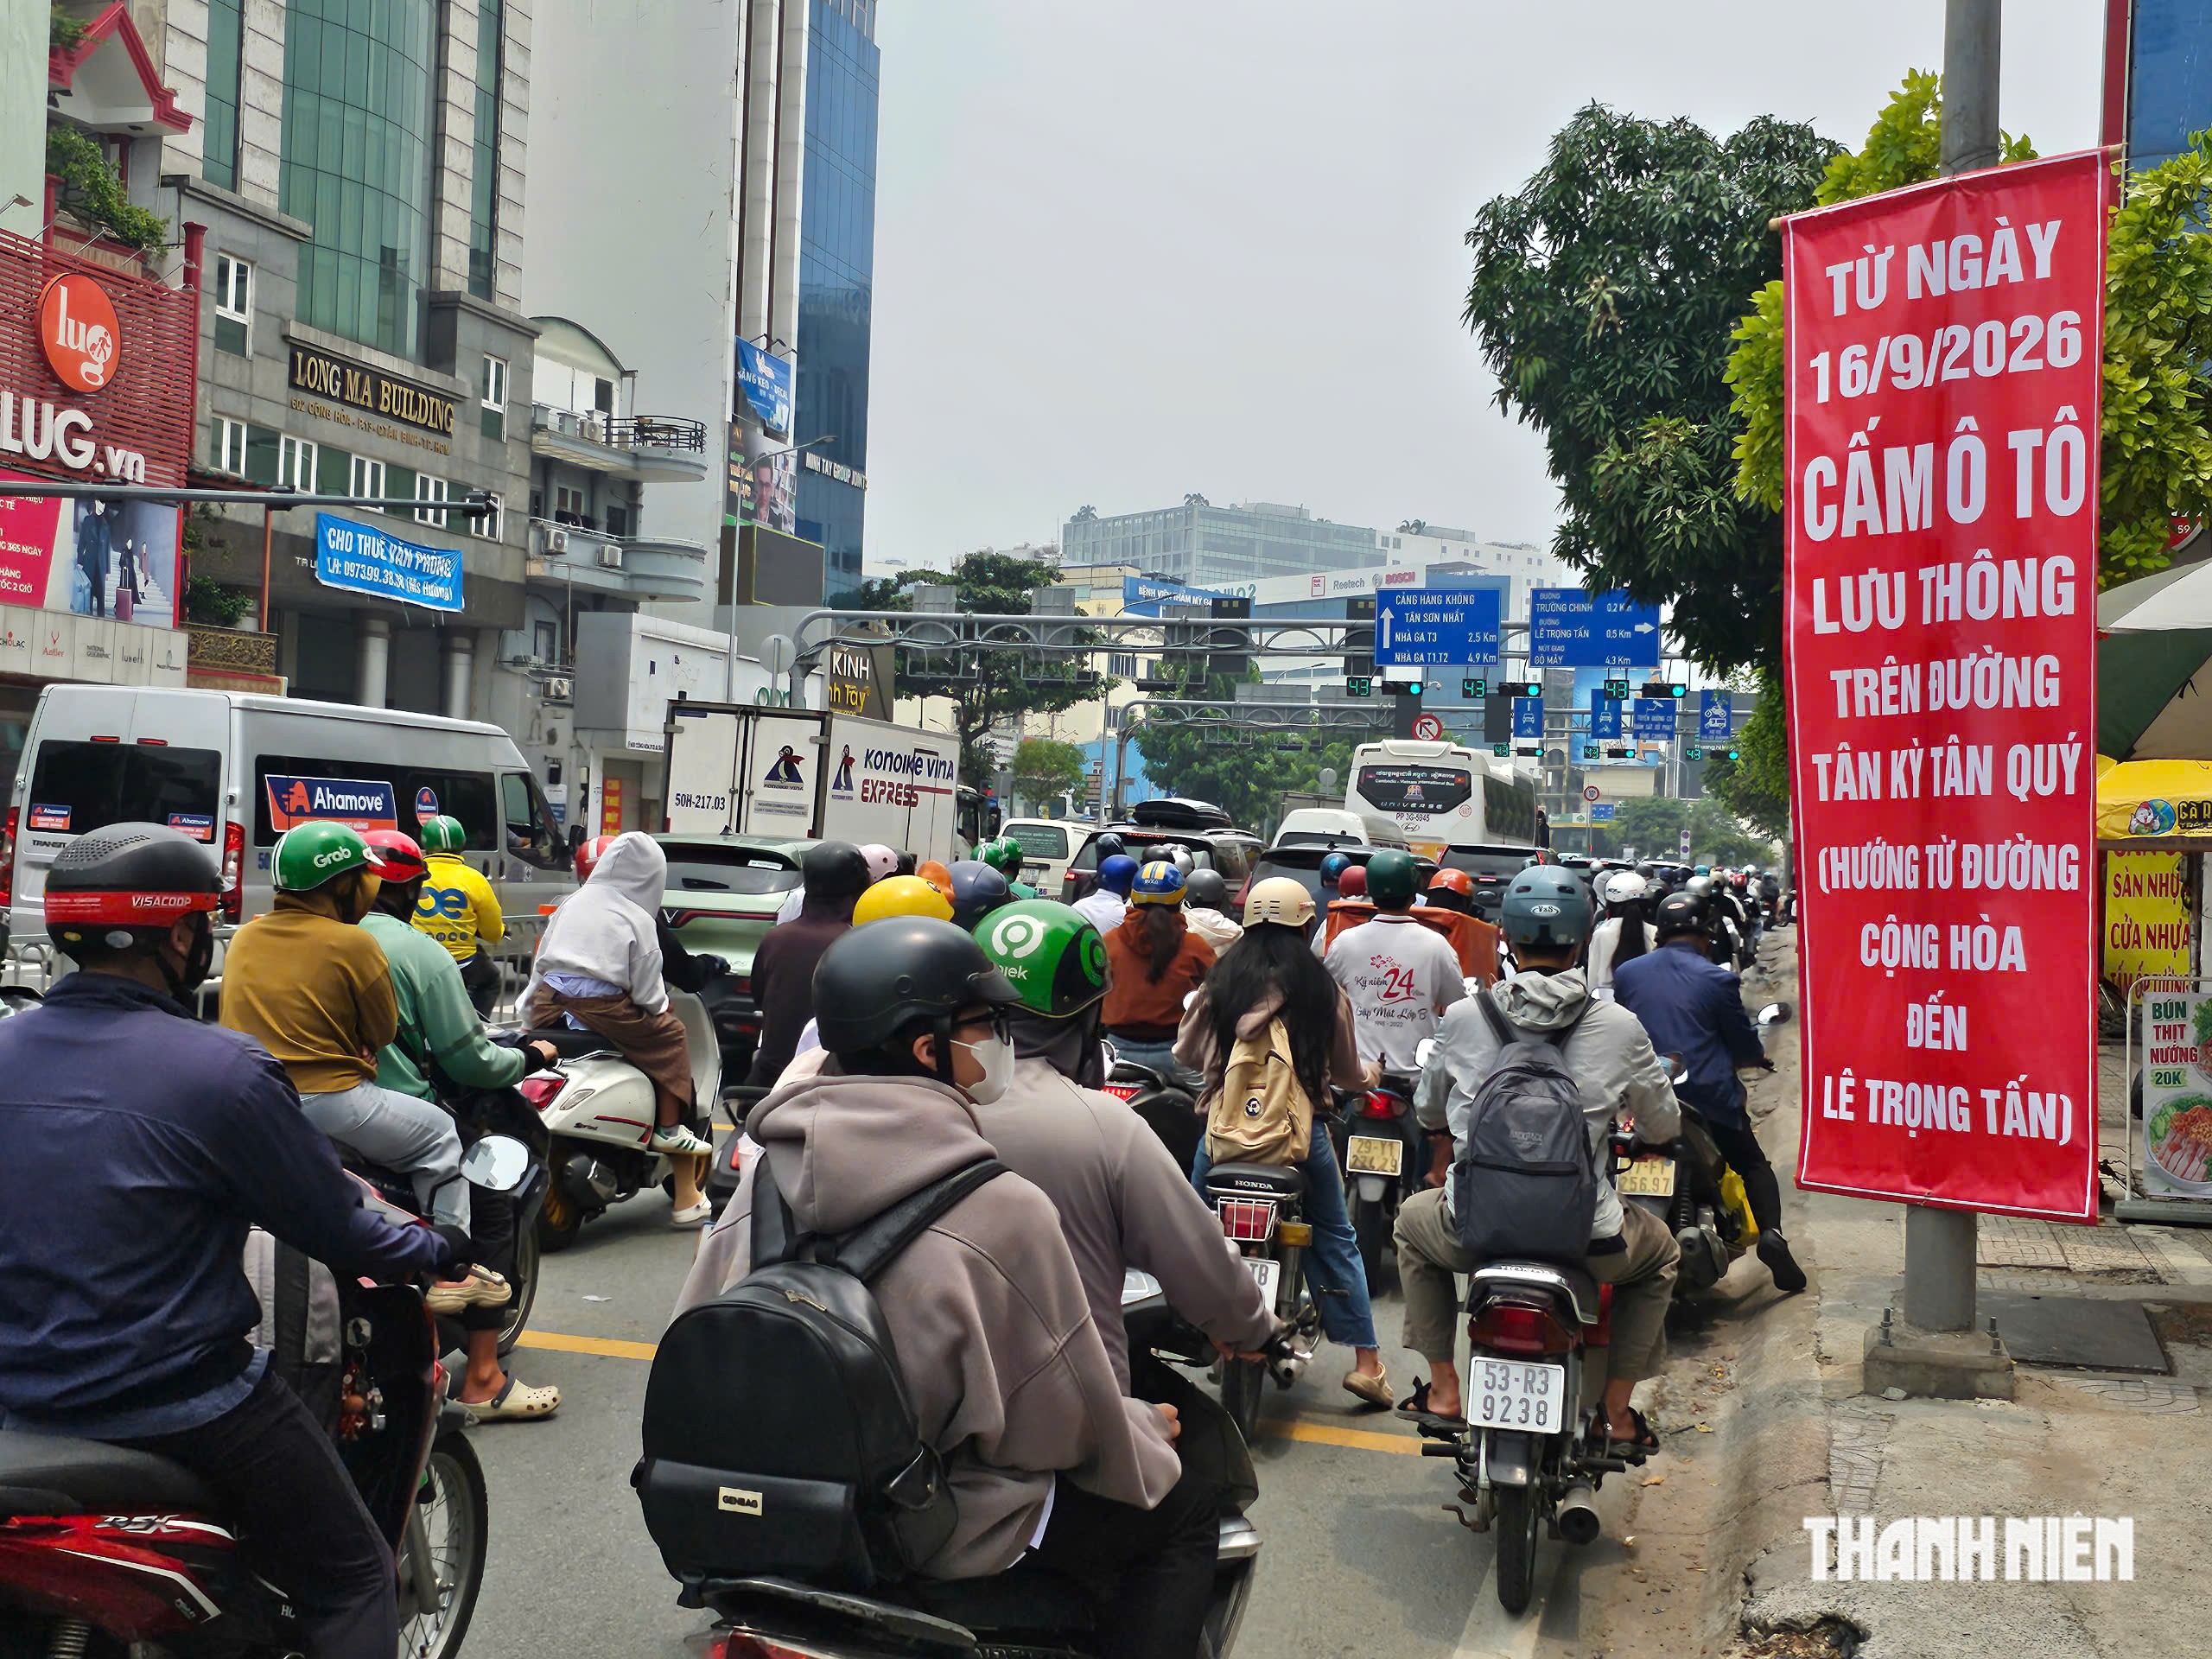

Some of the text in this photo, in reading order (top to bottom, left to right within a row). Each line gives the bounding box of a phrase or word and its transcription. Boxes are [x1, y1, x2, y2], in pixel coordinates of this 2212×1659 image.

[1826, 216, 2062, 317] TỪ NGÀY
[56, 285, 112, 386] lug
[1810, 310, 2082, 404] 16/9/2026
[294, 351, 455, 435] LONG MA BUILDING
[0, 391, 145, 484] LUG.vn
[833, 462, 851, 484] GROUP
[1803, 405, 2086, 542] CẤM Ô TÔ
[22, 544, 42, 556] NGÀY
[327, 527, 452, 578] CHO THUÊ VĂN PHÒNG
[1333, 578, 1365, 590] Reetech
[1385, 571, 1415, 585] BOSCH
[1139, 585, 1155, 598] BỆNH
[1395, 591, 1475, 605] CẢNG HÀNG KHÔNG
[1813, 548, 2075, 634] LƯU THÔNG
[1405, 607, 1465, 623] TÂN SƠN NHẤT
[1536, 602, 1567, 613] TRƯỜNG
[1568, 603, 1592, 613] CHINH
[1606, 603, 1618, 613] 0.2
[1395, 629, 1497, 643] NHÀ GA T3 2.5 Km
[1535, 627, 1545, 639] LÊ
[1547, 629, 1572, 640] TRỌNG
[1573, 625, 1589, 639] TẤN
[1618, 630, 1631, 639] Km
[832, 647, 869, 680] KÍNH
[1395, 650, 1412, 663] NHÀ
[1414, 652, 1425, 663] GA
[1467, 652, 1480, 663] 4.9
[1483, 652, 1497, 663] Km
[1605, 655, 1616, 664] 4.3
[1618, 656, 1630, 664] Km
[1348, 678, 1370, 697] 43
[1464, 679, 1485, 698] 43
[1605, 681, 1628, 699] 43
[1830, 645, 2060, 718] TRÊN ĐƯỜNG
[1812, 732, 2082, 803] TÂN KỲ TÂN QUÝ
[314, 785, 384, 811] Ahamove
[675, 792, 726, 811] 50H-217.03
[861, 779, 918, 808] EXPRESS
[1395, 812, 1404, 821] PP
[2179, 802, 2197, 820] GÀ
[313, 846, 352, 868] Grab
[1818, 832, 2079, 893] (HƯỚNG TỪ ĐƯỜNG
[2113, 865, 2143, 899] SÀN
[132, 895, 192, 908] VISACOOP
[1860, 913, 2026, 977] CỘNG HÒA
[2110, 912, 2190, 957] CỬA NHỰA
[1382, 967, 1415, 998] 24
[2152, 998, 2187, 1019] BÚN
[1907, 989, 1967, 1051] ĐẾN
[2153, 1023, 2186, 1044] THỊT
[2150, 1042, 2198, 1064] NƯỚNG
[2155, 1071, 2182, 1085] 20K
[1823, 1067, 2072, 1146] LÊ TRỌNG TẤN)
[1235, 1180, 1274, 1190] HONDA
[1620, 1176, 1670, 1193] 256.97
[1484, 1363, 1549, 1395] 53-R3
[1482, 1394, 1548, 1427] 9238
[94, 1514, 182, 1534] RSX
